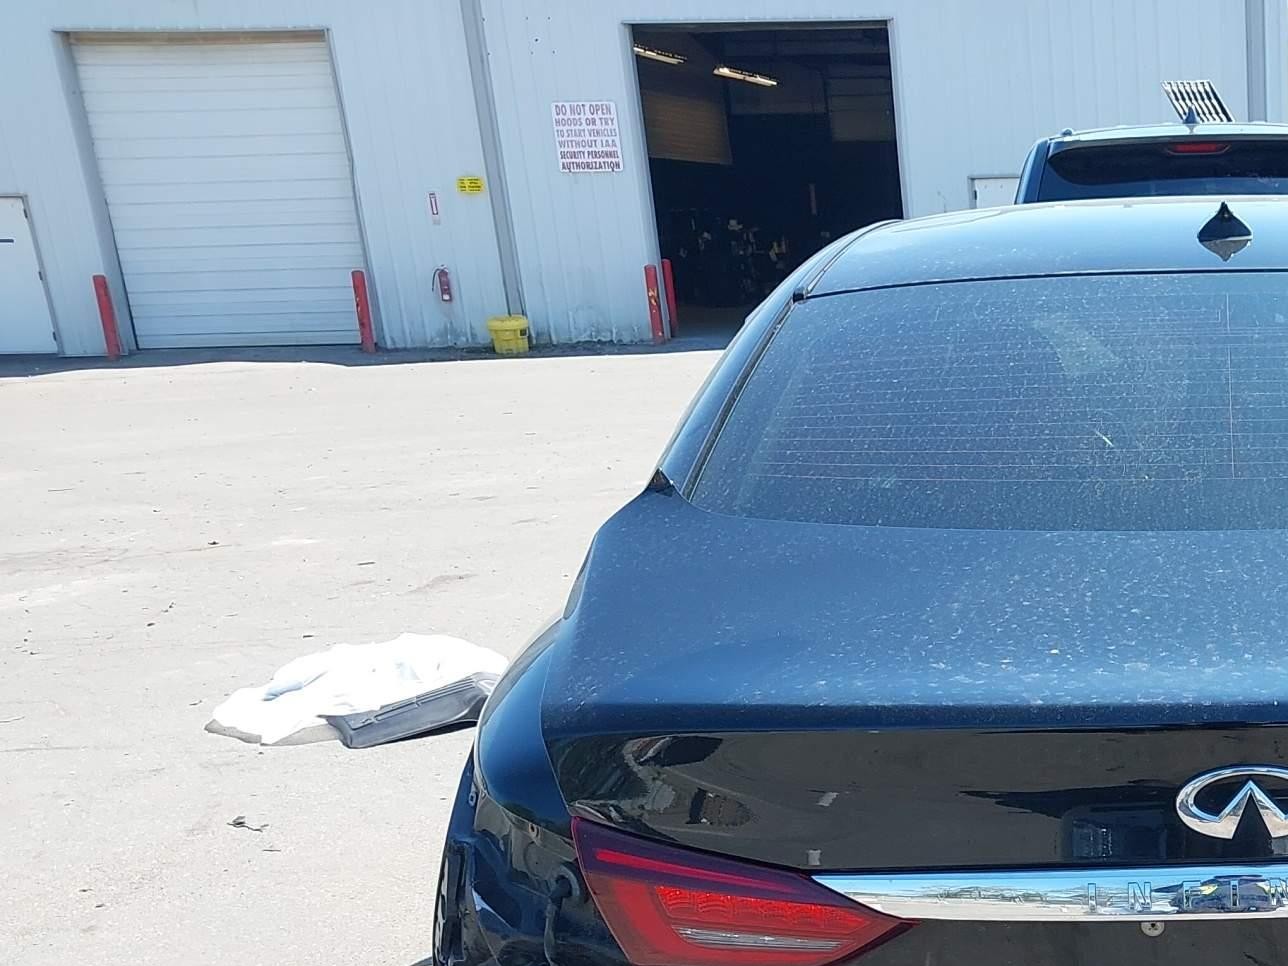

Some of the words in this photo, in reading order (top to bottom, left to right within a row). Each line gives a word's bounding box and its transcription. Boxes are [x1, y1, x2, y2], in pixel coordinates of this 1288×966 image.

[555, 104, 567, 116] DO
[569, 104, 586, 116] NOT
[589, 104, 611, 116] OPEN
[555, 118, 583, 127] HOODS
[585, 117, 597, 127] OR
[599, 118, 615, 126] TRY
[556, 129, 565, 138] TO
[566, 129, 586, 138] START
[588, 128, 618, 138] VEHICLES
[558, 140, 597, 149] WITHOUT
[600, 139, 617, 148] IAA
[560, 150, 586, 160] SECURITY
[587, 150, 619, 160] PERSONNEL
[561, 161, 621, 171] AUTHORIZATION
